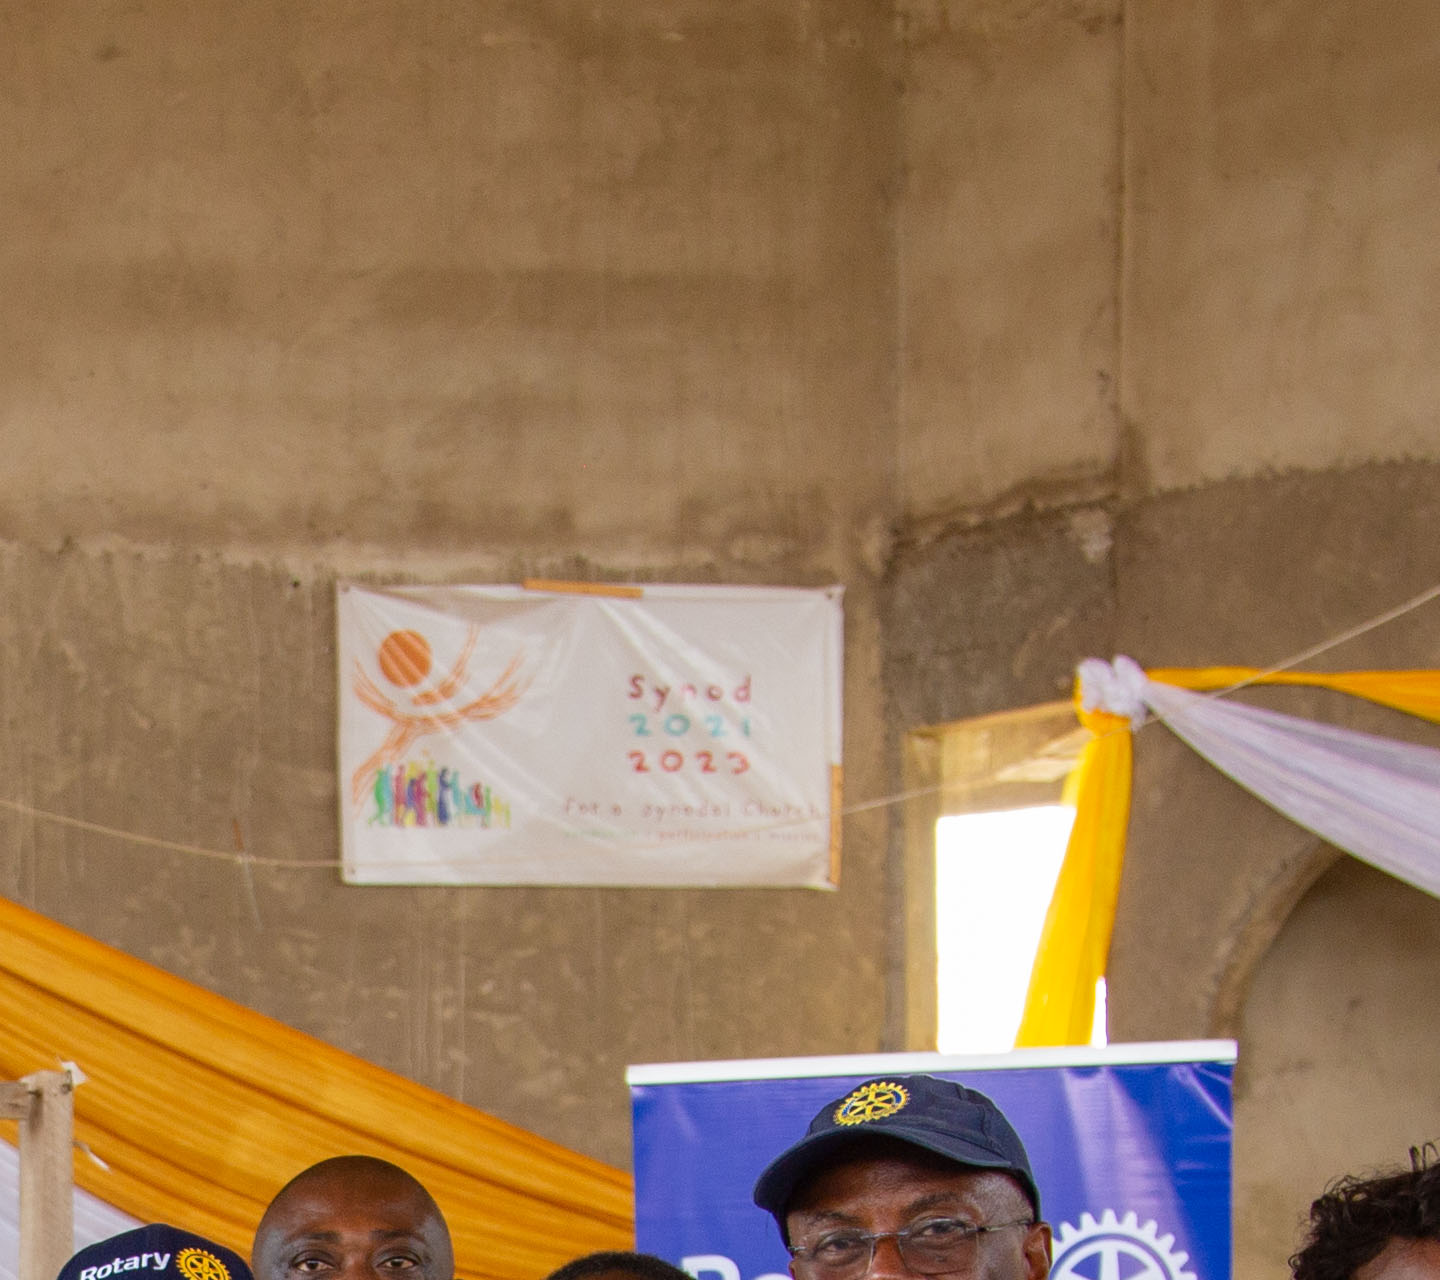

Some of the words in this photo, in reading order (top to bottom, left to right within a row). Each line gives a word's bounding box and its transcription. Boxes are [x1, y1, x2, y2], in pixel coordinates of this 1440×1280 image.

[628, 675, 752, 711] Synod
[628, 714, 751, 738] 2021
[628, 751, 751, 774] 2023
